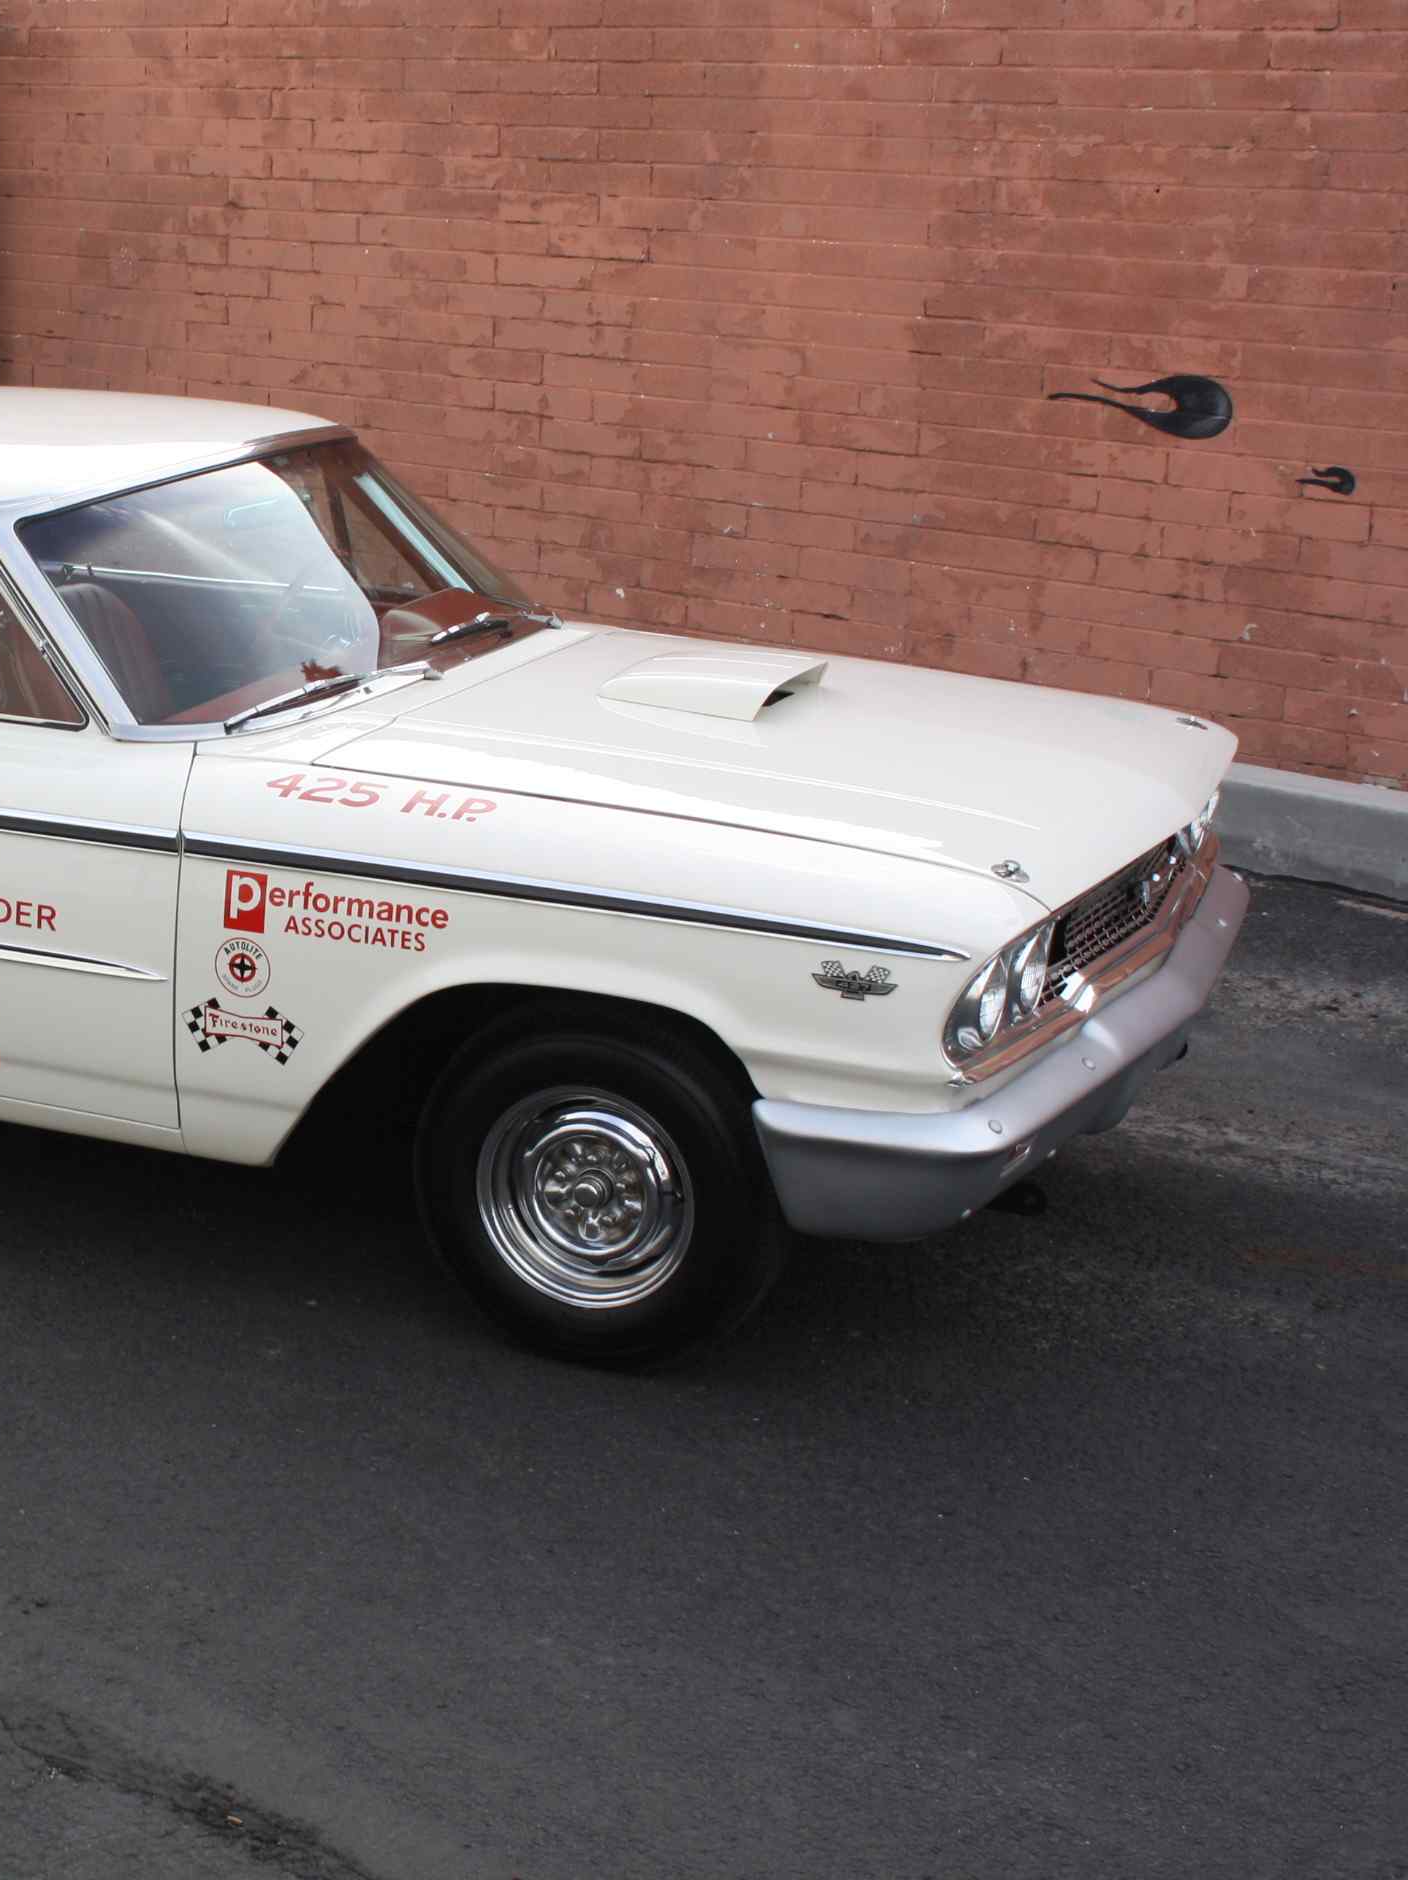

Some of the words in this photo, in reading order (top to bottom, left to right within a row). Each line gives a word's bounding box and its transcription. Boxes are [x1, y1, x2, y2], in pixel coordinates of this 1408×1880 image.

[266, 773, 389, 809] 425
[400, 789, 498, 823] H.P.
[283, 915, 427, 953] ASSOCIATES
[223, 941, 264, 960] AUTOLITE
[208, 1013, 278, 1037] Firestone
